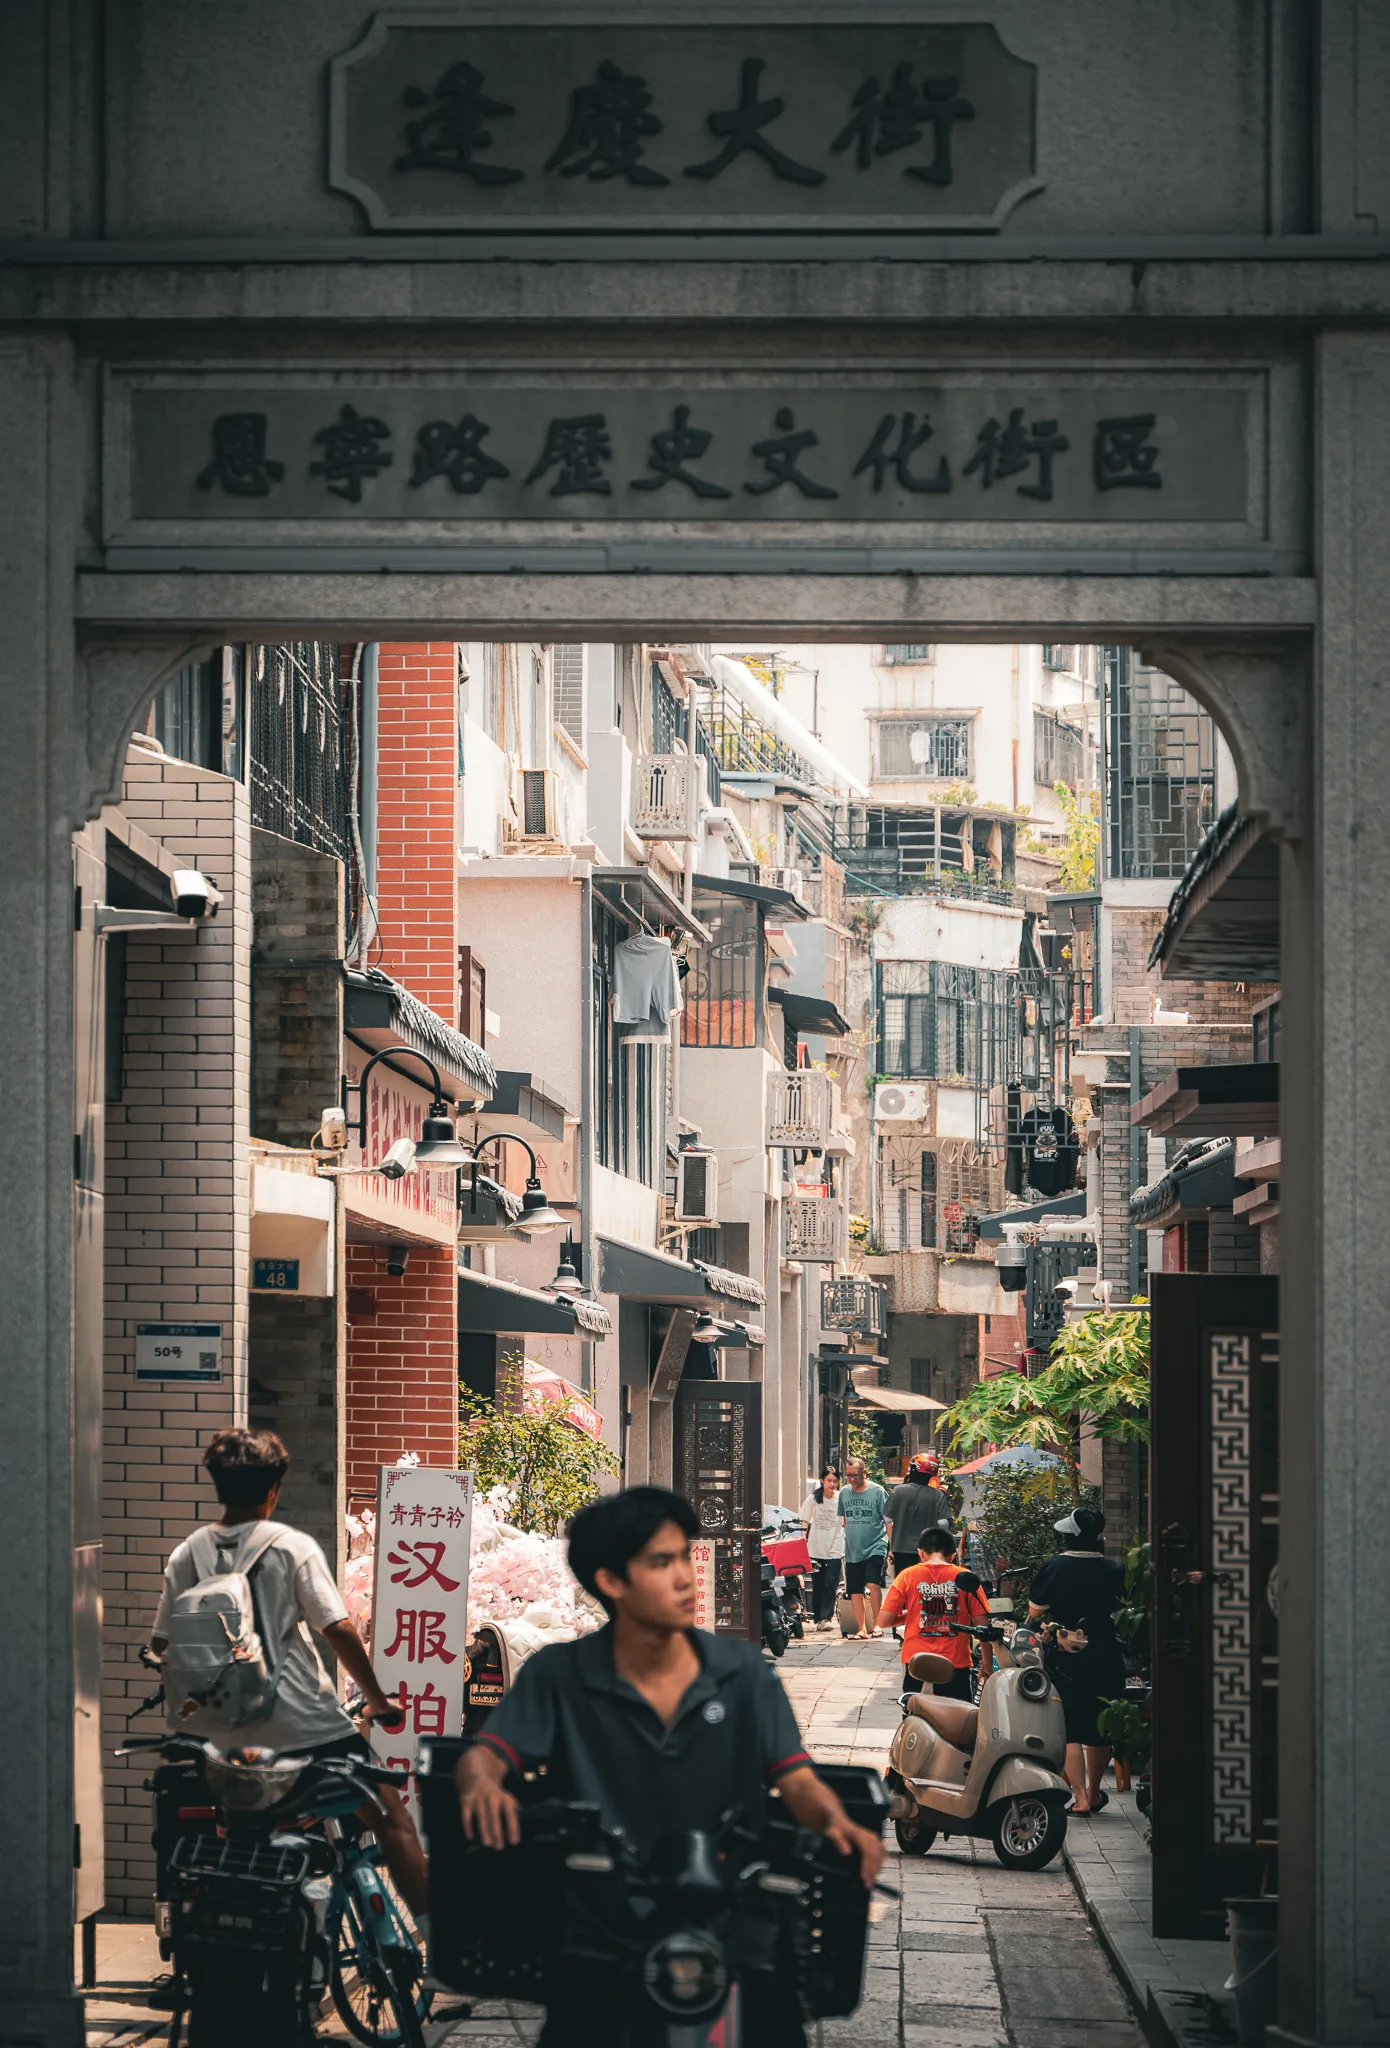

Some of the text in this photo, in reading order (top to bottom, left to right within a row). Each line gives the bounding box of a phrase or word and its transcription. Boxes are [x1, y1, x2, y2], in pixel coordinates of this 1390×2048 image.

[195, 402, 1163, 504] 恩寧路歷史文化街區
[266, 1272, 286, 1287] 48
[154, 1345, 182, 1359] 50号
[845, 1499, 873, 1510] BASKETBALL
[388, 1502, 465, 1529] 青青子衿
